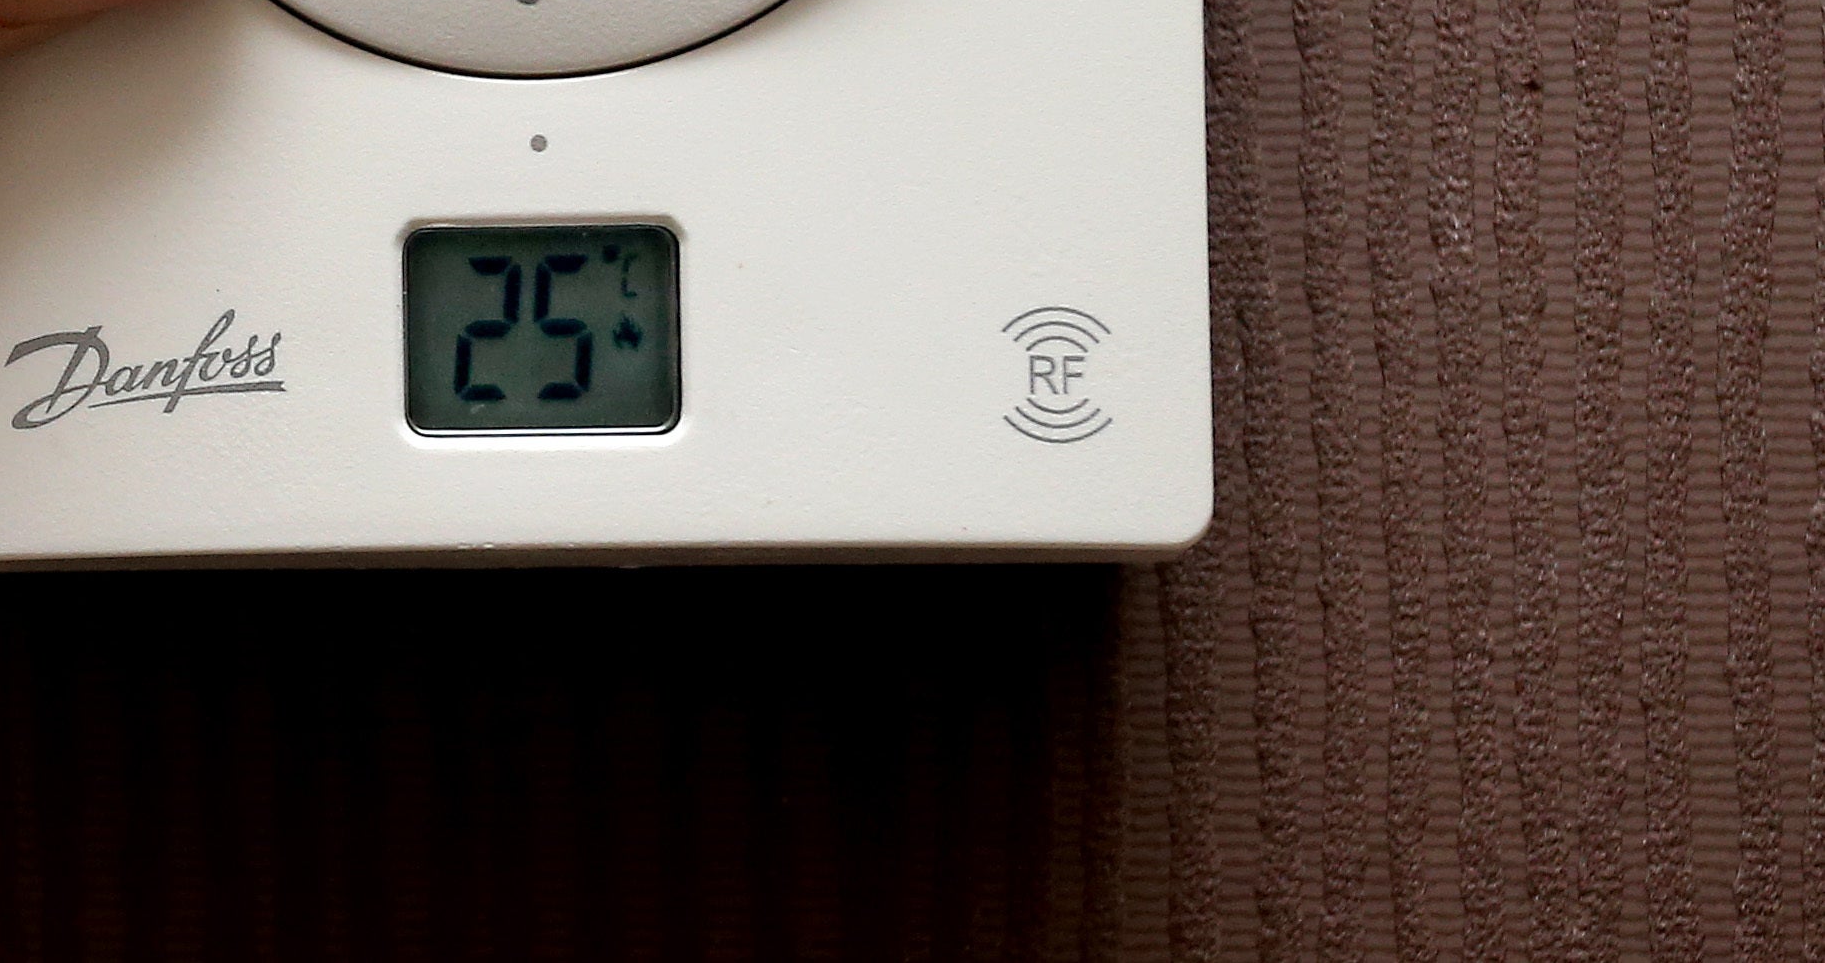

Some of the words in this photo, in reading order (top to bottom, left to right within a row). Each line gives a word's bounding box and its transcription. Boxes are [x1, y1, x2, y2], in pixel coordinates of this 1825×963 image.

[4, 308, 286, 430] Danfoss
[453, 254, 594, 402] 25
[1029, 354, 1086, 395] RF
